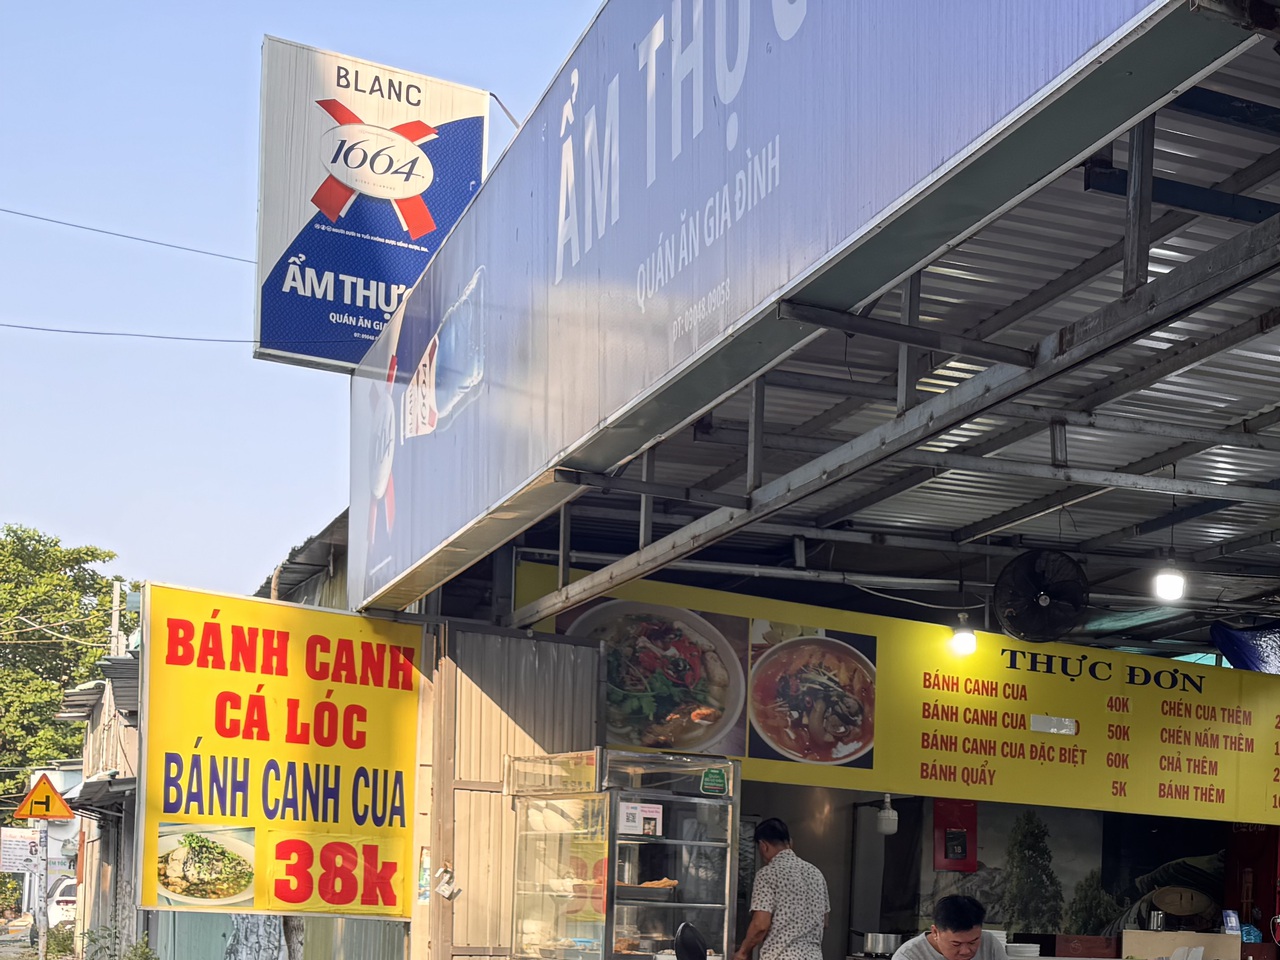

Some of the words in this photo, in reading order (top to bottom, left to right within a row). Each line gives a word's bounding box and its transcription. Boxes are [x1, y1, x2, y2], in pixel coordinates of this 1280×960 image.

[336, 65, 422, 107] BLANC
[555, 68, 619, 285] ẨM
[638, 0, 807, 189] THỰ
[636, 232, 675, 314] QUÁN
[678, 208, 699, 272] ĂN
[704, 183, 731, 247] GIA
[735, 134, 780, 221] ĐÌNH
[282, 254, 334, 301] ẨM
[339, 273, 412, 320] THỰ
[329, 312, 356, 326] QUÁN
[357, 316, 371, 329] ĂN
[165, 609, 290, 677] BÁNH
[305, 634, 415, 691] CANH
[923, 669, 959, 693] BÁNH
[964, 677, 998, 697] CANH
[1003, 682, 1028, 701] CUA
[1001, 649, 1112, 682] THỰC
[1126, 665, 1206, 694] ĐƠN
[214, 684, 270, 741] CÁ
[285, 689, 367, 750] LÓC
[922, 699, 959, 723] BÁNH
[963, 707, 997, 727] CANH
[1002, 712, 1027, 730] CUA
[1106, 696, 1130, 713] 40K
[1161, 698, 1192, 719] CHÉN
[1195, 704, 1217, 722] CUA
[1220, 705, 1252, 726] THÊM
[921, 729, 958, 752] BÁNH
[962, 736, 997, 757] CANH
[1001, 741, 1026, 760] CUA
[1029, 741, 1055, 765] ĐẶC
[1059, 744, 1088, 767] BIỆT
[1107, 724, 1130, 741] 50K
[1160, 726, 1191, 746] CHÉN
[1194, 727, 1220, 749] NẤM
[1222, 733, 1255, 753] THÊM
[920, 759, 957, 782] BÁNH
[961, 760, 996, 786] QUẨY
[1106, 752, 1129, 770] 60K
[1159, 751, 1182, 772] CHẢ
[1186, 756, 1218, 776] THÊM
[163, 736, 250, 817] BÁNH
[262, 758, 341, 823] CANH
[352, 766, 406, 828] CUA
[1111, 781, 1127, 797] 5K
[1158, 780, 1190, 801] BÁNH
[1193, 784, 1225, 804] THÊM
[274, 839, 397, 906] 38k
